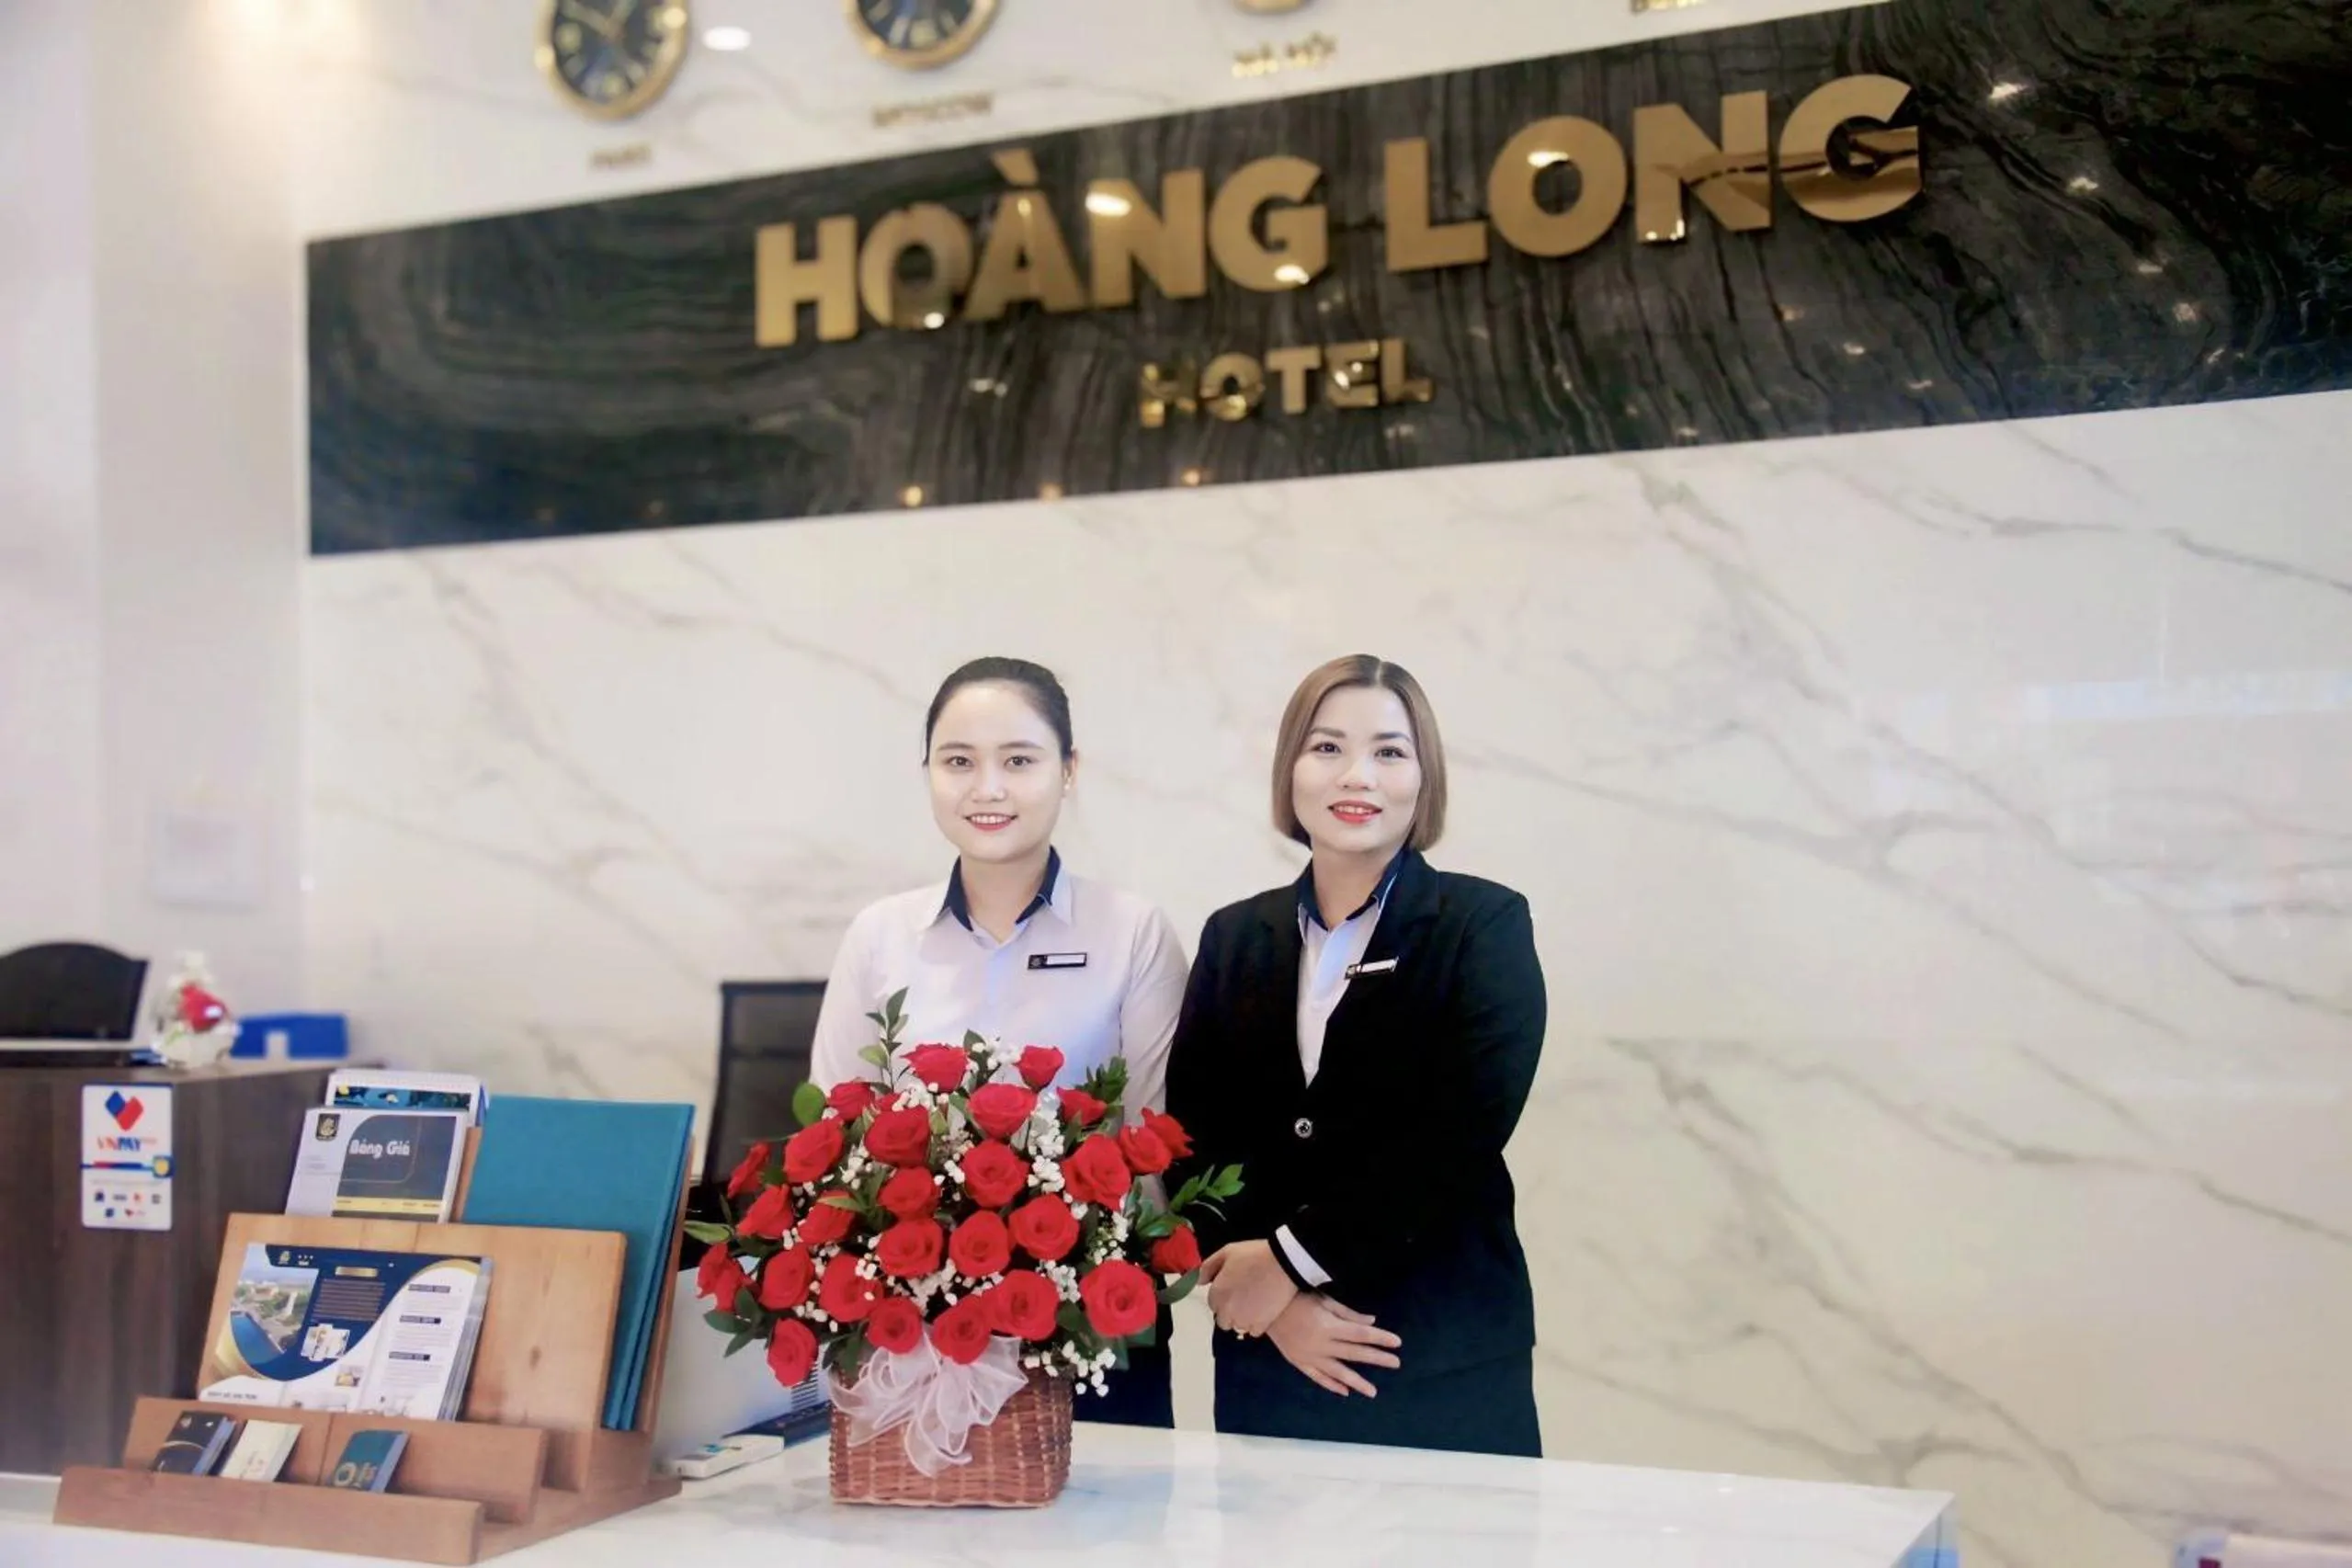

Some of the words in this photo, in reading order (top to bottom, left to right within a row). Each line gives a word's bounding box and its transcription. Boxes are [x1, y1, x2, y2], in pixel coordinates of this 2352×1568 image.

[756, 148, 1328, 347] HOÀNG
[1384, 74, 1923, 273] LONG
[1141, 337, 1433, 428] HOTEL
